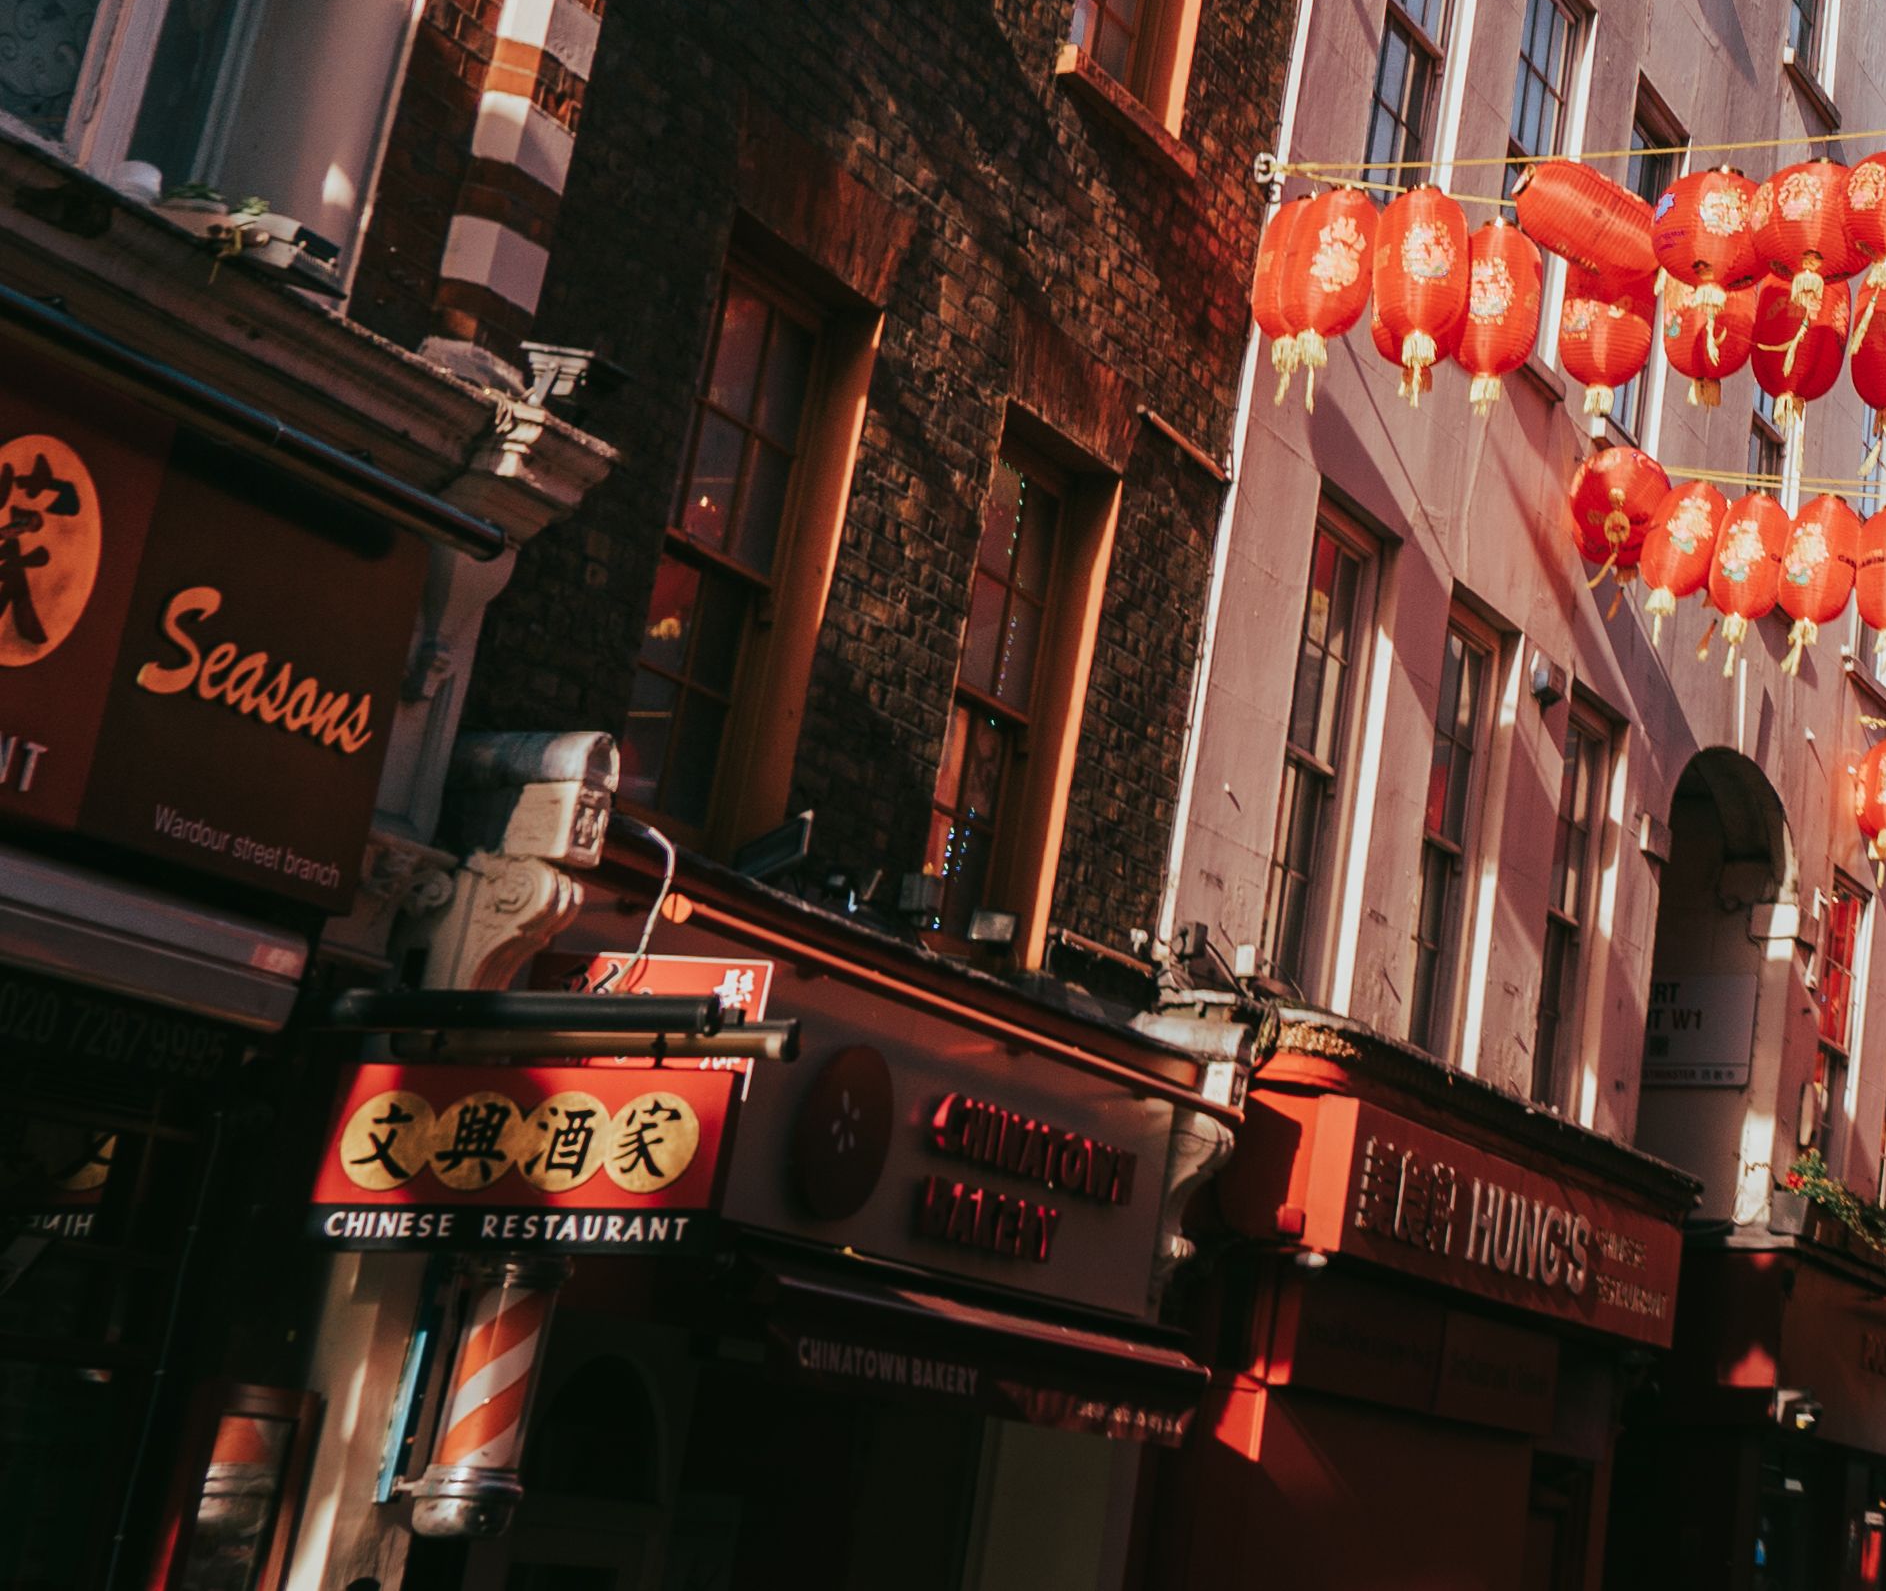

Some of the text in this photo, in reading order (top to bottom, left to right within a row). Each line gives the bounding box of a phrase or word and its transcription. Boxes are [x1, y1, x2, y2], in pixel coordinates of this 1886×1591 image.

[136, 586, 374, 754] Seasons
[154, 803, 341, 888] Wardour street branch
[66, 996, 147, 1063] 7287
[1672, 1010, 1702, 1030] W1
[349, 1099, 683, 1184] 文興酒家
[931, 1092, 1137, 1206] CHINATOWN
[323, 1211, 690, 1243] CHINESE RESTAURANT
[1464, 1176, 1592, 1296] HUNG'S
[798, 1336, 979, 1397] CHINATOWN BAKERY
